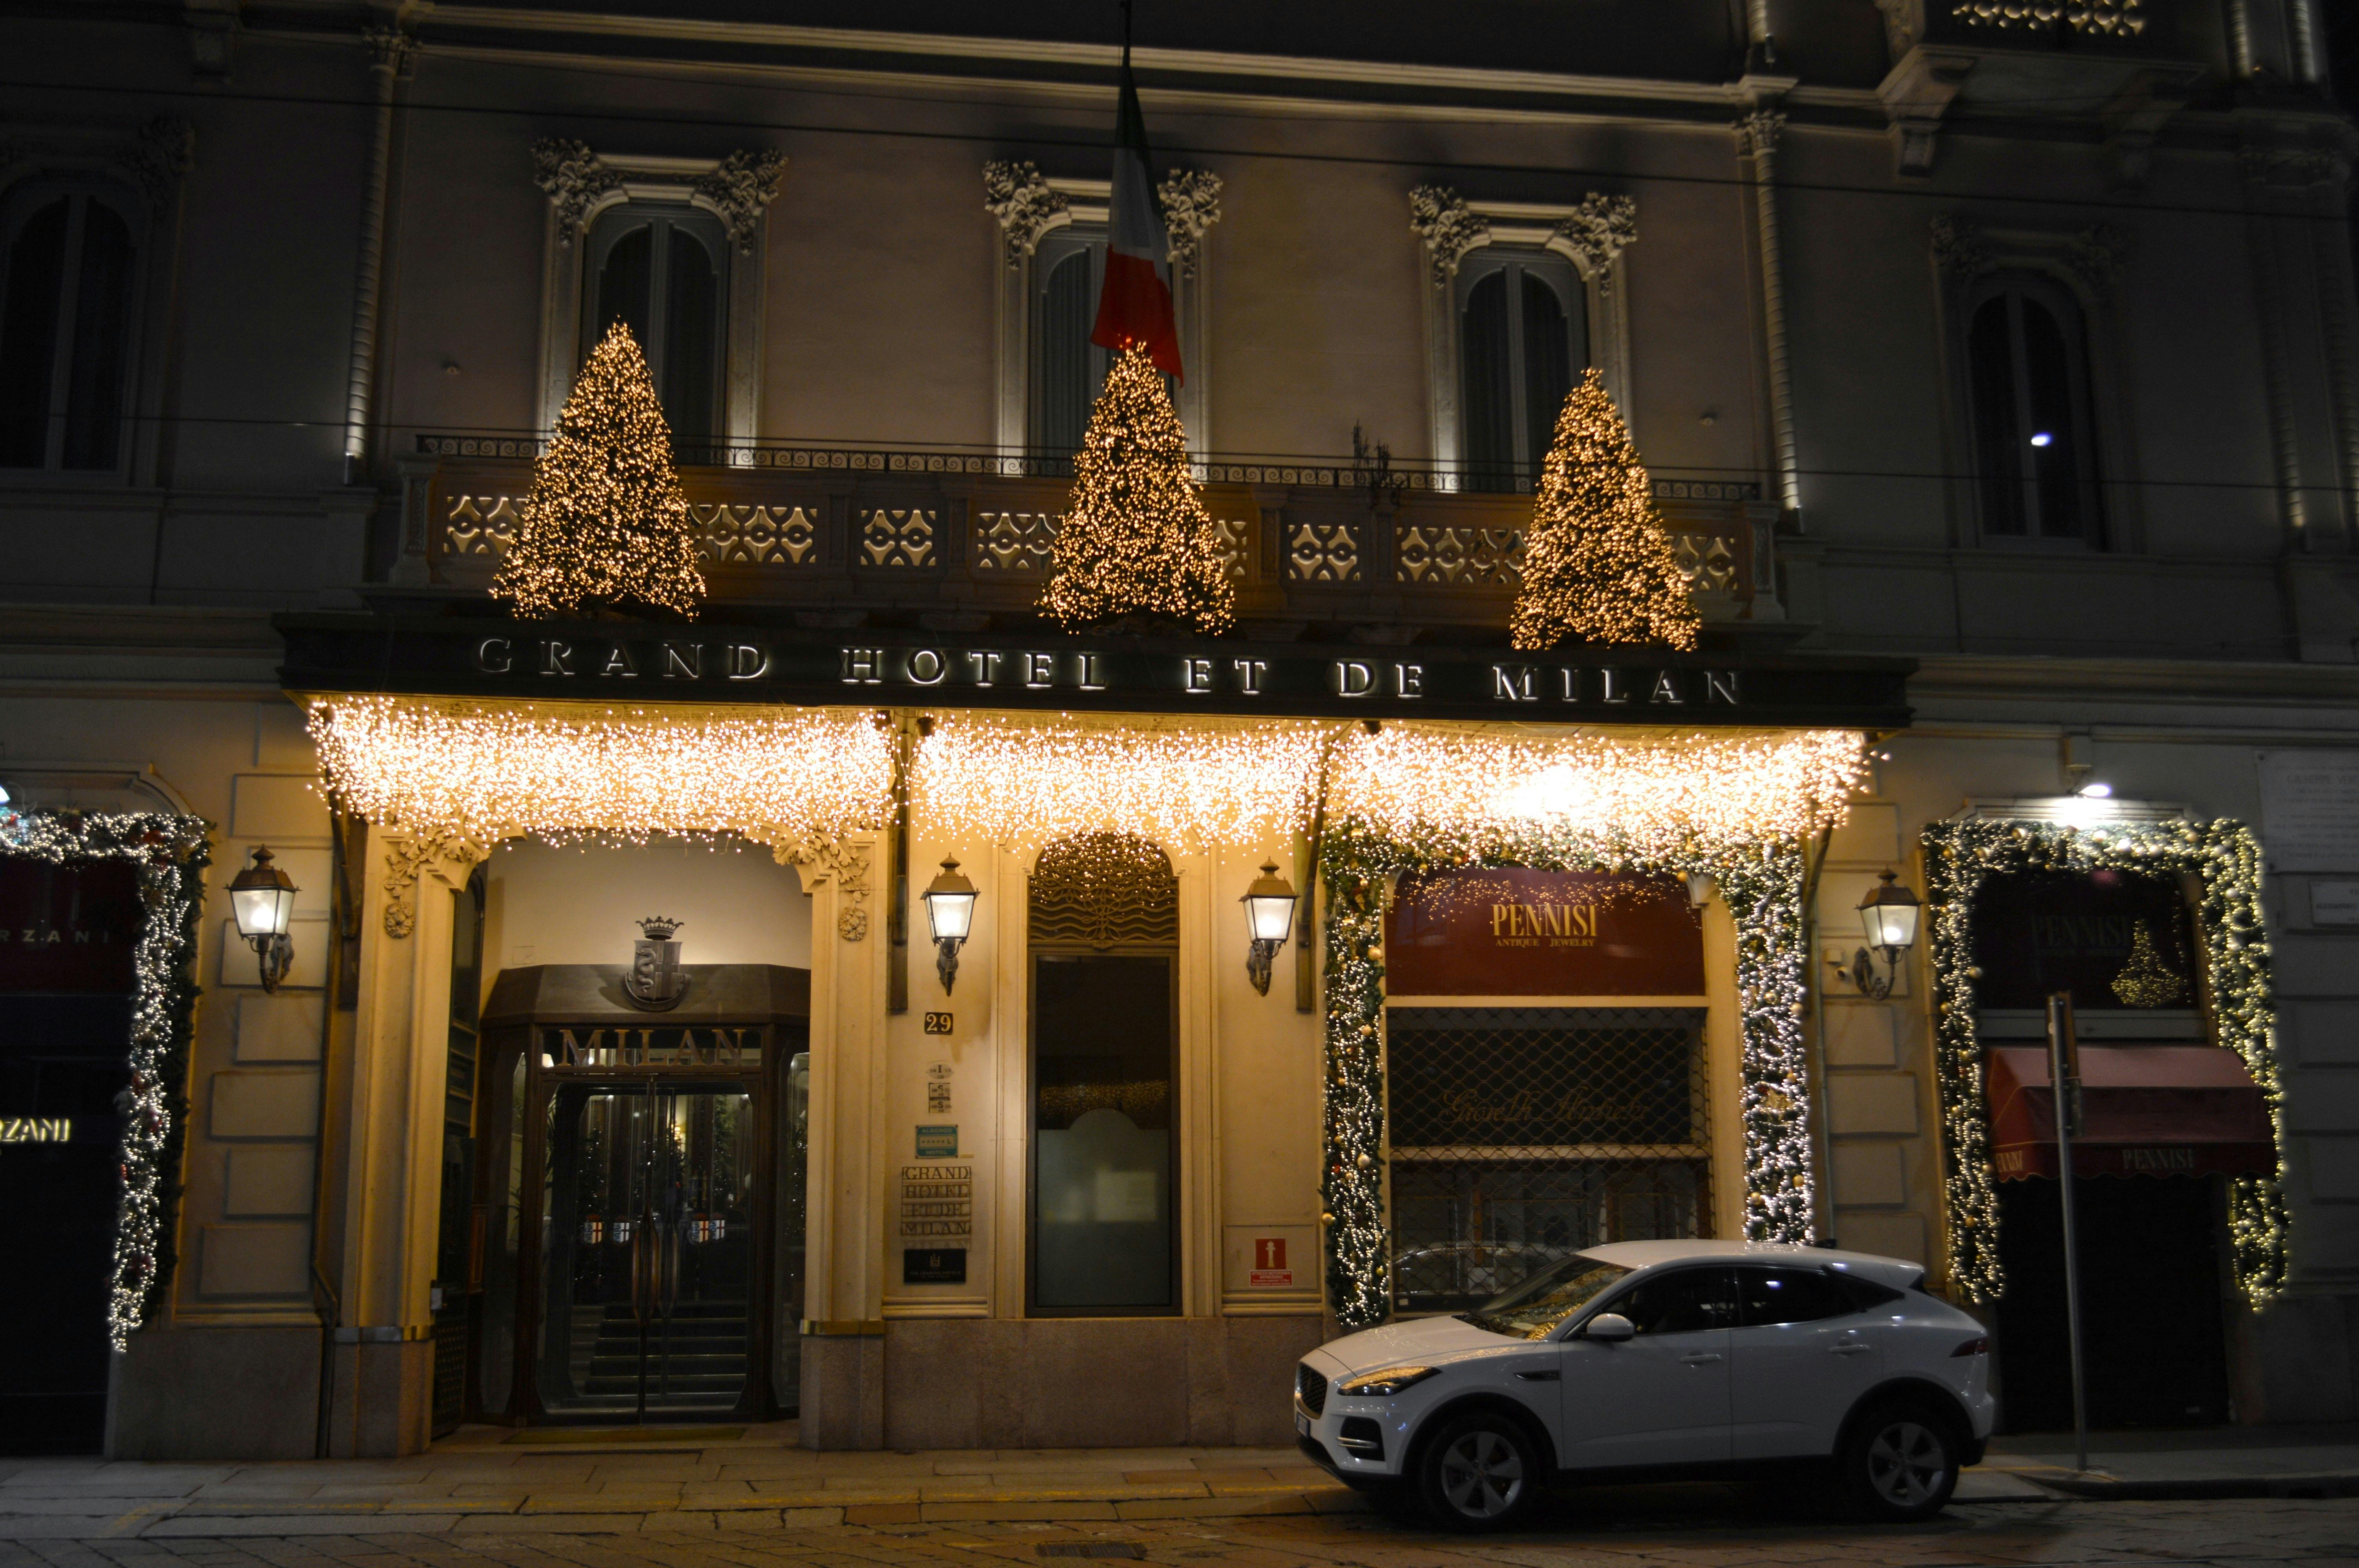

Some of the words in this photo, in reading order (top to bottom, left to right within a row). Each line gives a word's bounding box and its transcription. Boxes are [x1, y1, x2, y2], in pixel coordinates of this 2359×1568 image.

[478, 638, 767, 680] GRAND
[841, 646, 1107, 691] HOTEL
[1183, 658, 1267, 695] ET
[1336, 660, 1424, 699] DE
[1492, 663, 1740, 705] MILAN
[1491, 904, 1597, 936] PENNISI
[2030, 915, 2127, 946] PENNISI
[1496, 938, 1539, 947] ANTIQUE
[1549, 938, 1595, 947] JEWELRY
[926, 1013, 951, 1032] 29
[559, 1029, 746, 1067] MILAN
[0, 1118, 71, 1142] ZANI
[2121, 1148, 2195, 1170] PENNISI
[905, 1167, 969, 1180] GRAND
[906, 1185, 970, 1197] HOTEL
[906, 1221, 967, 1234] MILAN
